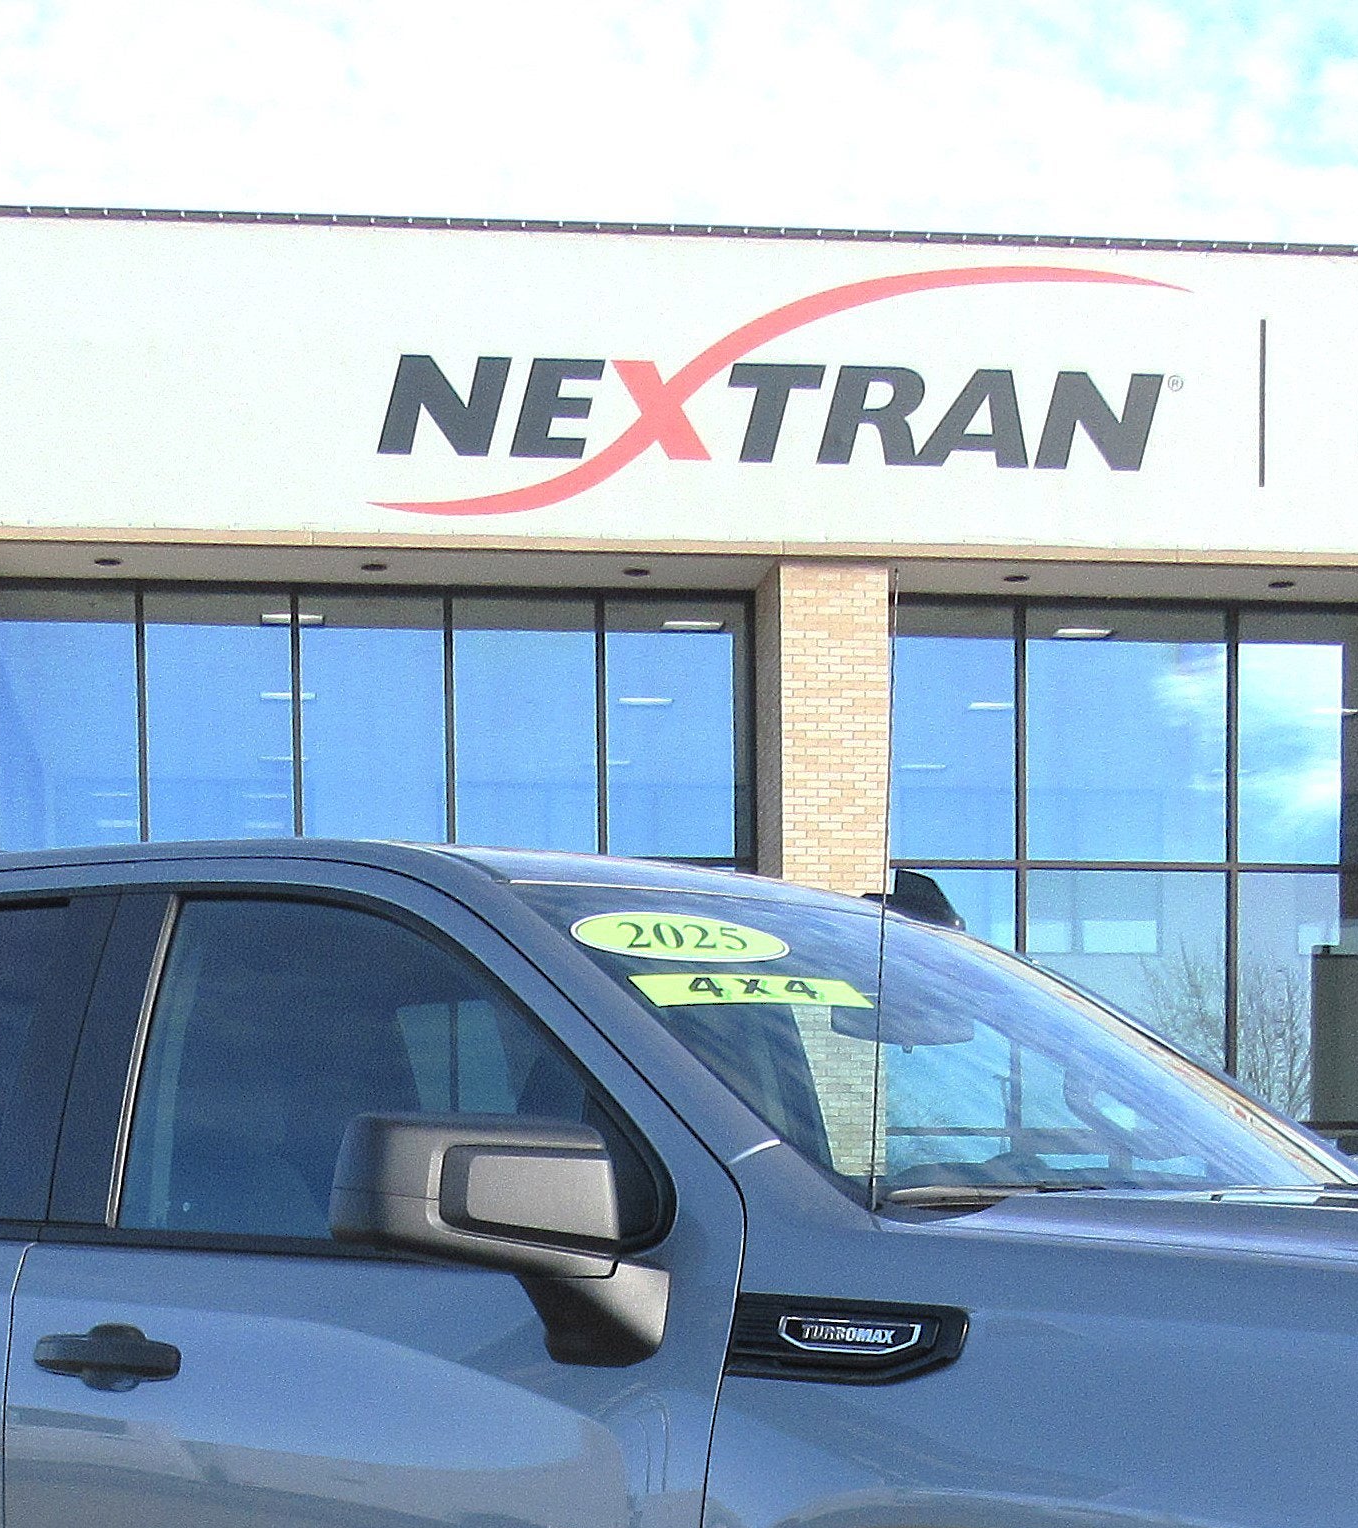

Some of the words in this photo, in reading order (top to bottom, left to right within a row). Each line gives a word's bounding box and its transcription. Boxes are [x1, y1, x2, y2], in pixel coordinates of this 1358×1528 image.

[377, 353, 1165, 472] NEXTRAN
[617, 920, 748, 951] 2025
[802, 1324, 896, 1344] TURBOMAX
